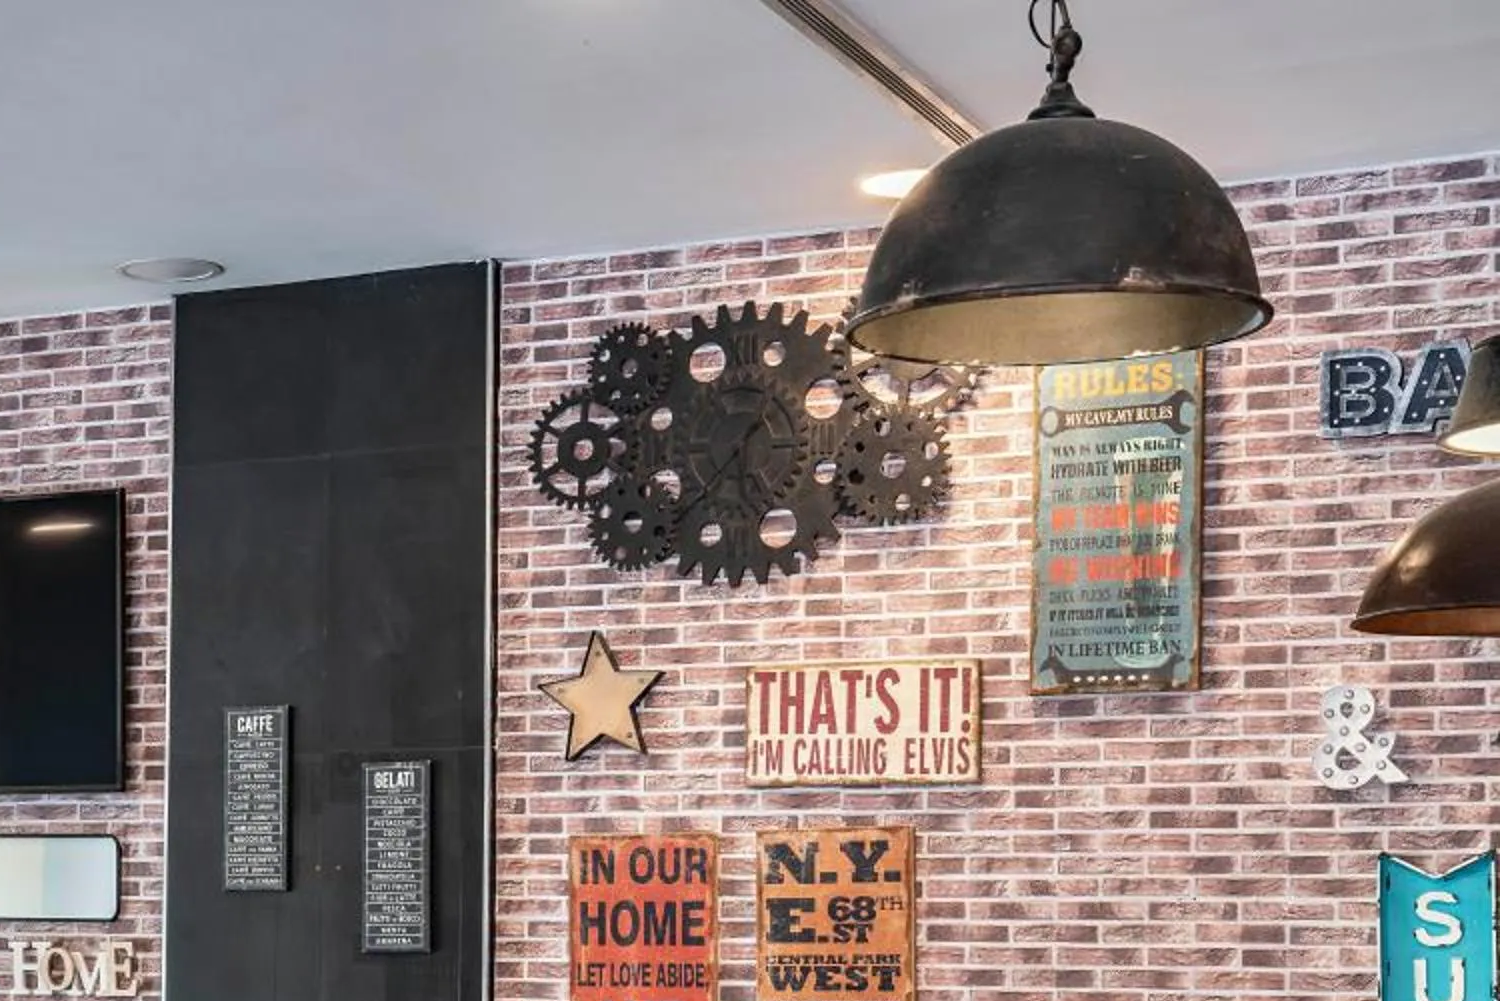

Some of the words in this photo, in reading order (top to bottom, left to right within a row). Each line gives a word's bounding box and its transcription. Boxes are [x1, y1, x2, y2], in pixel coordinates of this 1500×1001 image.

[1064, 412, 1082, 426] MY
[1117, 409, 1135, 423] MY
[1136, 405, 1173, 421] RULES
[1095, 440, 1141, 455] ALWAYS
[1051, 460, 1109, 479] HYDRATE
[1113, 457, 1148, 475] WITH
[1150, 455, 1181, 473] BEER
[1068, 641, 1145, 657] LIFETIME
[1149, 639, 1181, 655] BAN
[753, 667, 901, 735] THAT'S
[919, 667, 973, 733] IT!
[751, 739, 784, 776] I'M
[793, 737, 888, 776] CALLING
[904, 736, 971, 775] ELVIS
[374, 771, 415, 788] GELATI
[579, 849, 615, 885] IN
[629, 846, 708, 885] OUR
[579, 899, 706, 947] HOME
[833, 923, 873, 944] ST
[8, 941, 139, 997] HOME
[766, 954, 848, 965] CENTRAL
[852, 954, 902, 965] PARK
[577, 962, 606, 988] LET
[610, 962, 652, 988] LOVE
[766, 965, 902, 992] WEST
